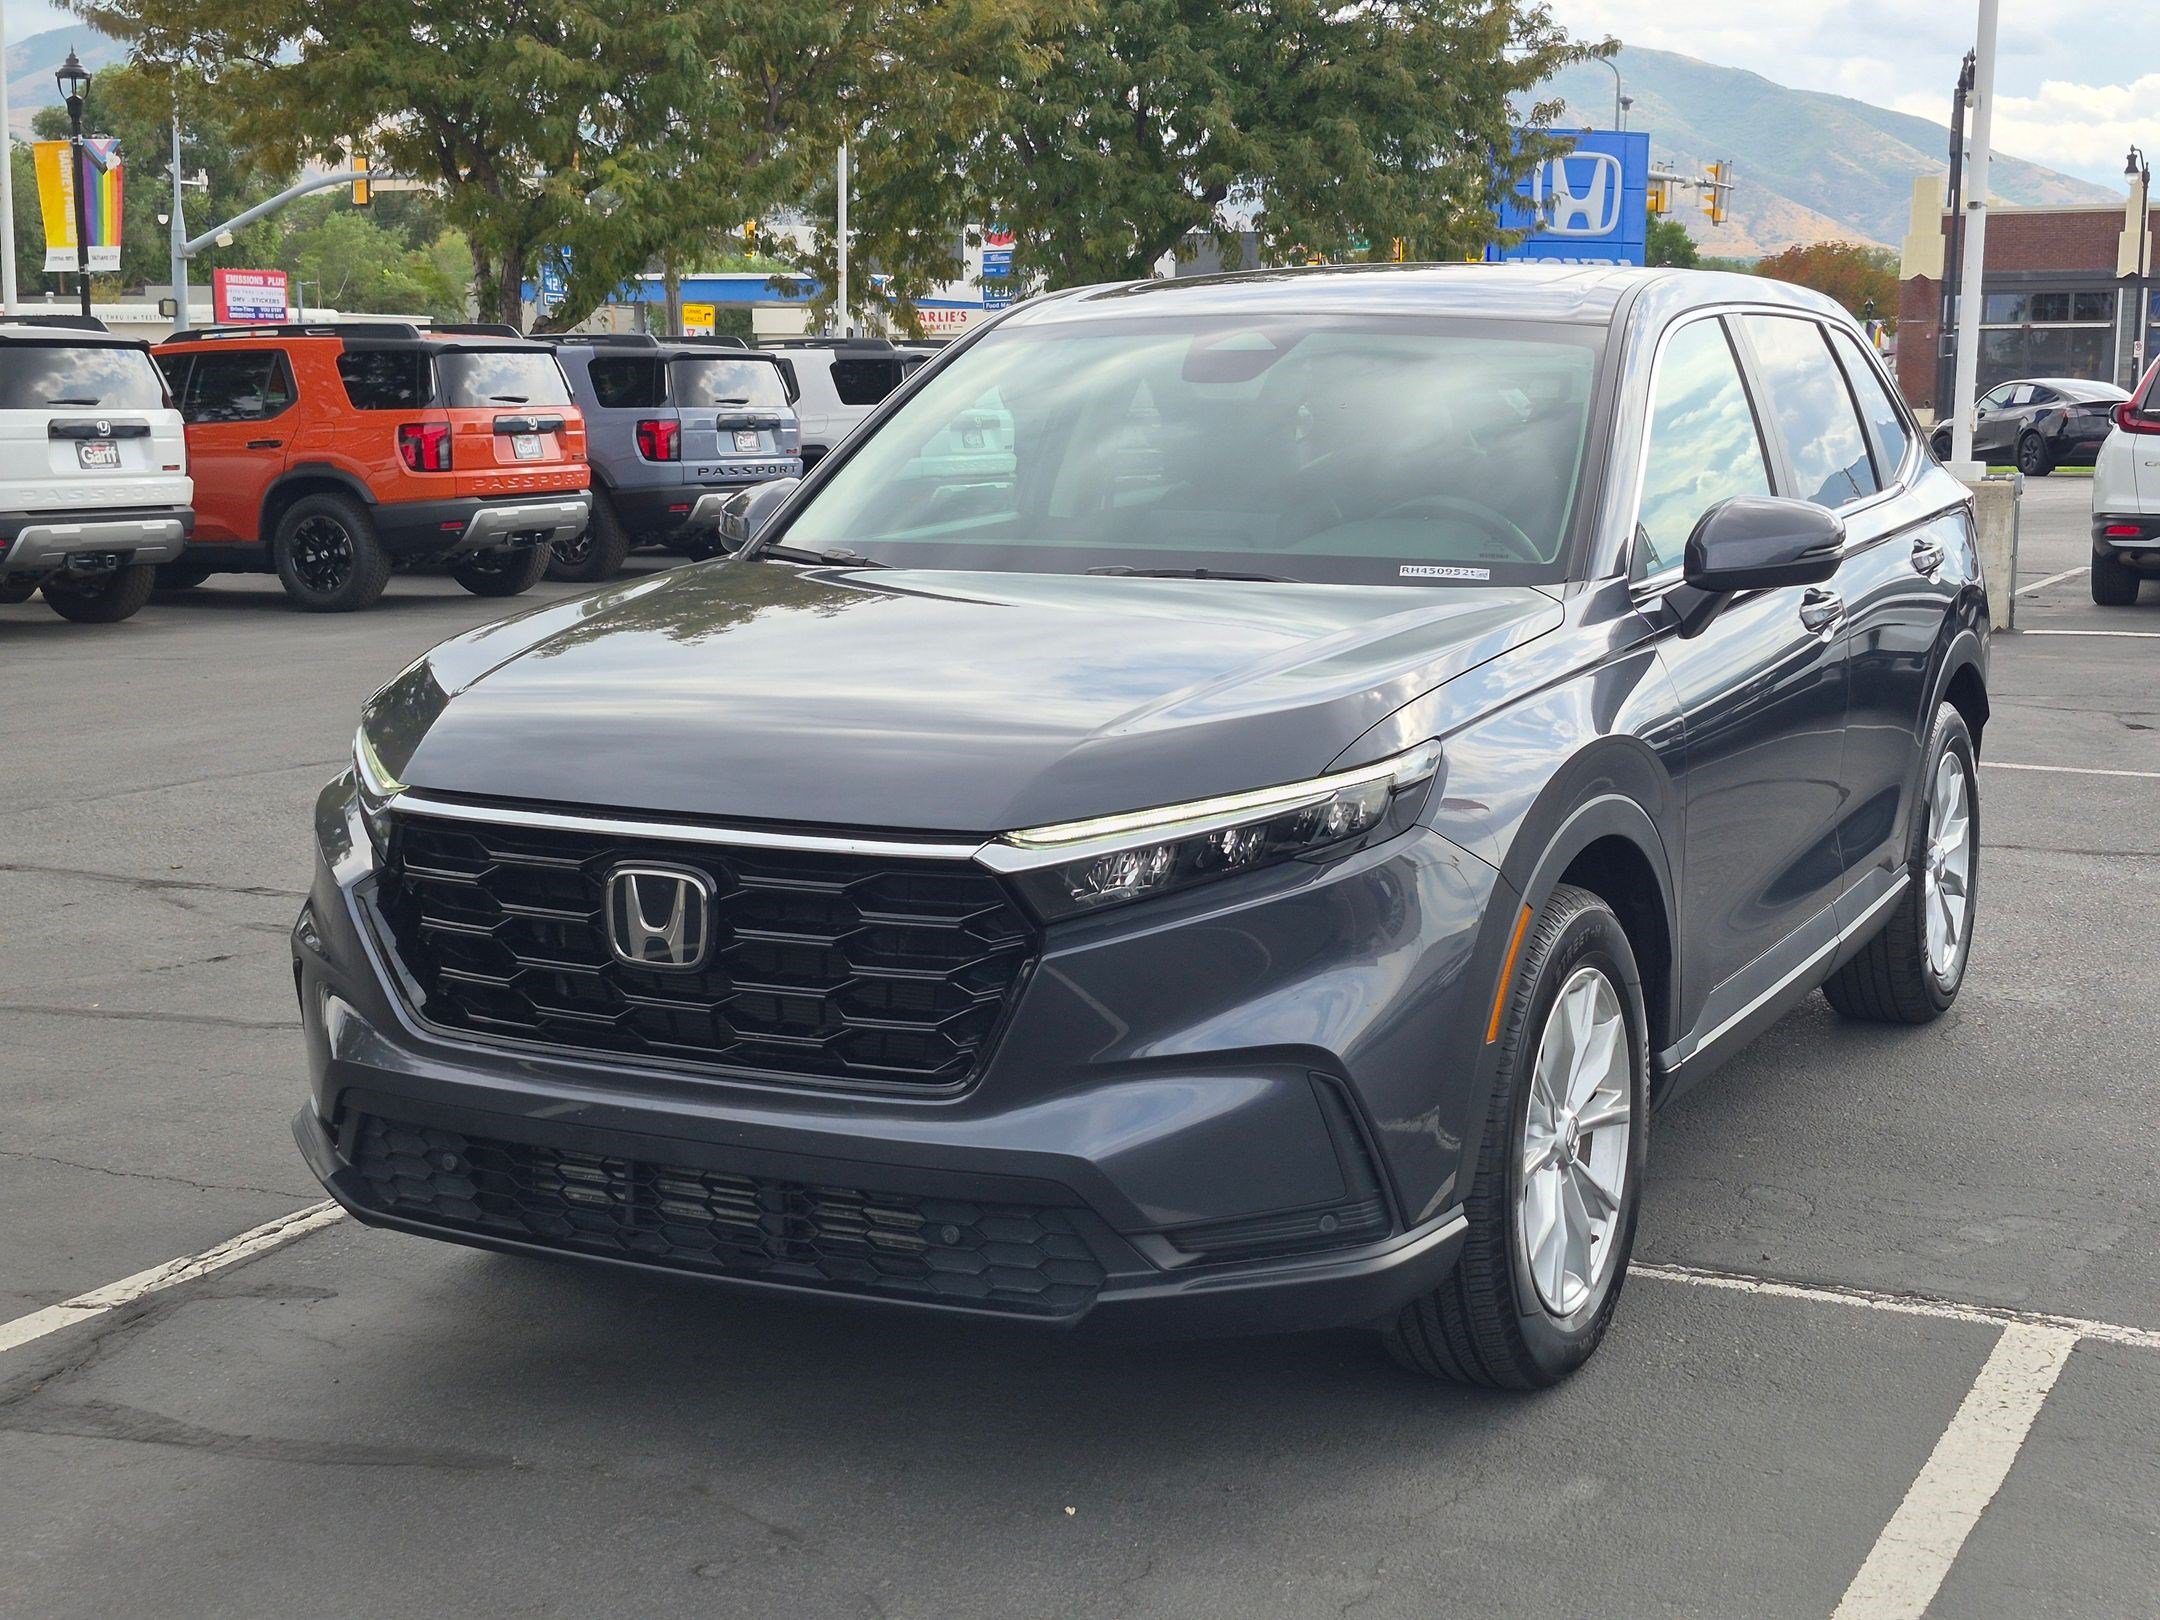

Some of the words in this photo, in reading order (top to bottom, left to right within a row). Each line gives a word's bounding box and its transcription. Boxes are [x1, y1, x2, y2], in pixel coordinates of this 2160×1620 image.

[226, 274, 264, 285] EMISSIONS
[267, 277, 285, 287] PLUS
[918, 311, 967, 323] ARLIE'S
[81, 445, 118, 464] Garff
[697, 464, 797, 477] PASSPORT
[471, 473, 585, 491] PASSPORT
[18, 485, 181, 504] PASSPORT
